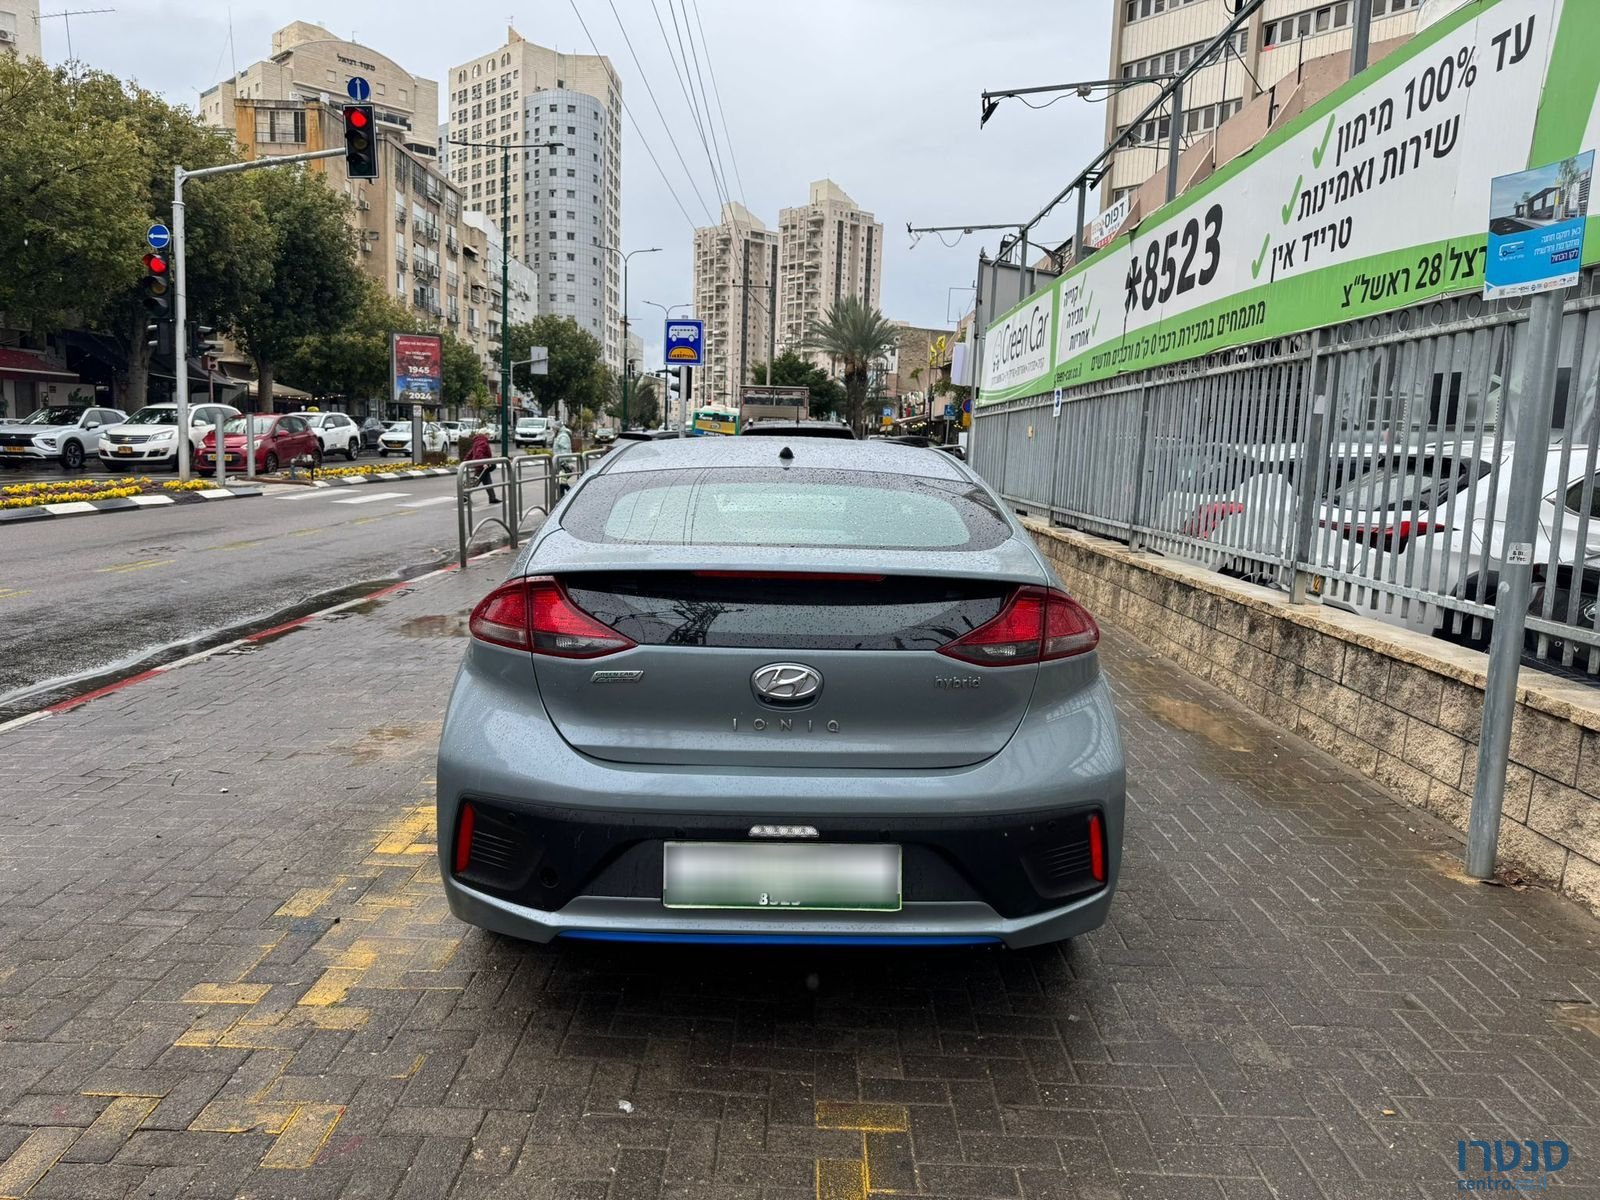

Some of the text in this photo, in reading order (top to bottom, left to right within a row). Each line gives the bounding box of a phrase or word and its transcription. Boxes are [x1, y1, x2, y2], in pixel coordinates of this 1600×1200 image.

[1335, 14, 1536, 167] עד 100% מימון
[1297, 113, 1461, 222] שירות ואמינות
[1104, 201, 1125, 229] דפוס
[1269, 215, 1353, 284] טרייד אין
[1449, 245, 1488, 281] רצל
[1415, 252, 1444, 290] 28
[1066, 306, 1084, 329] מכירה
[1217, 300, 1266, 336] מתמחים
[1001, 305, 1050, 365] Green Car
[1068, 328, 1091, 352] אחריות
[1158, 330, 1177, 353] רכבי
[1177, 318, 1215, 348] במכירת
[408, 365, 431, 375] 1945
[1090, 350, 1112, 372] חדשים
[408, 391, 432, 401] 2024
[935, 675, 982, 692] hybrid
[732, 717, 841, 734] IONIQ
